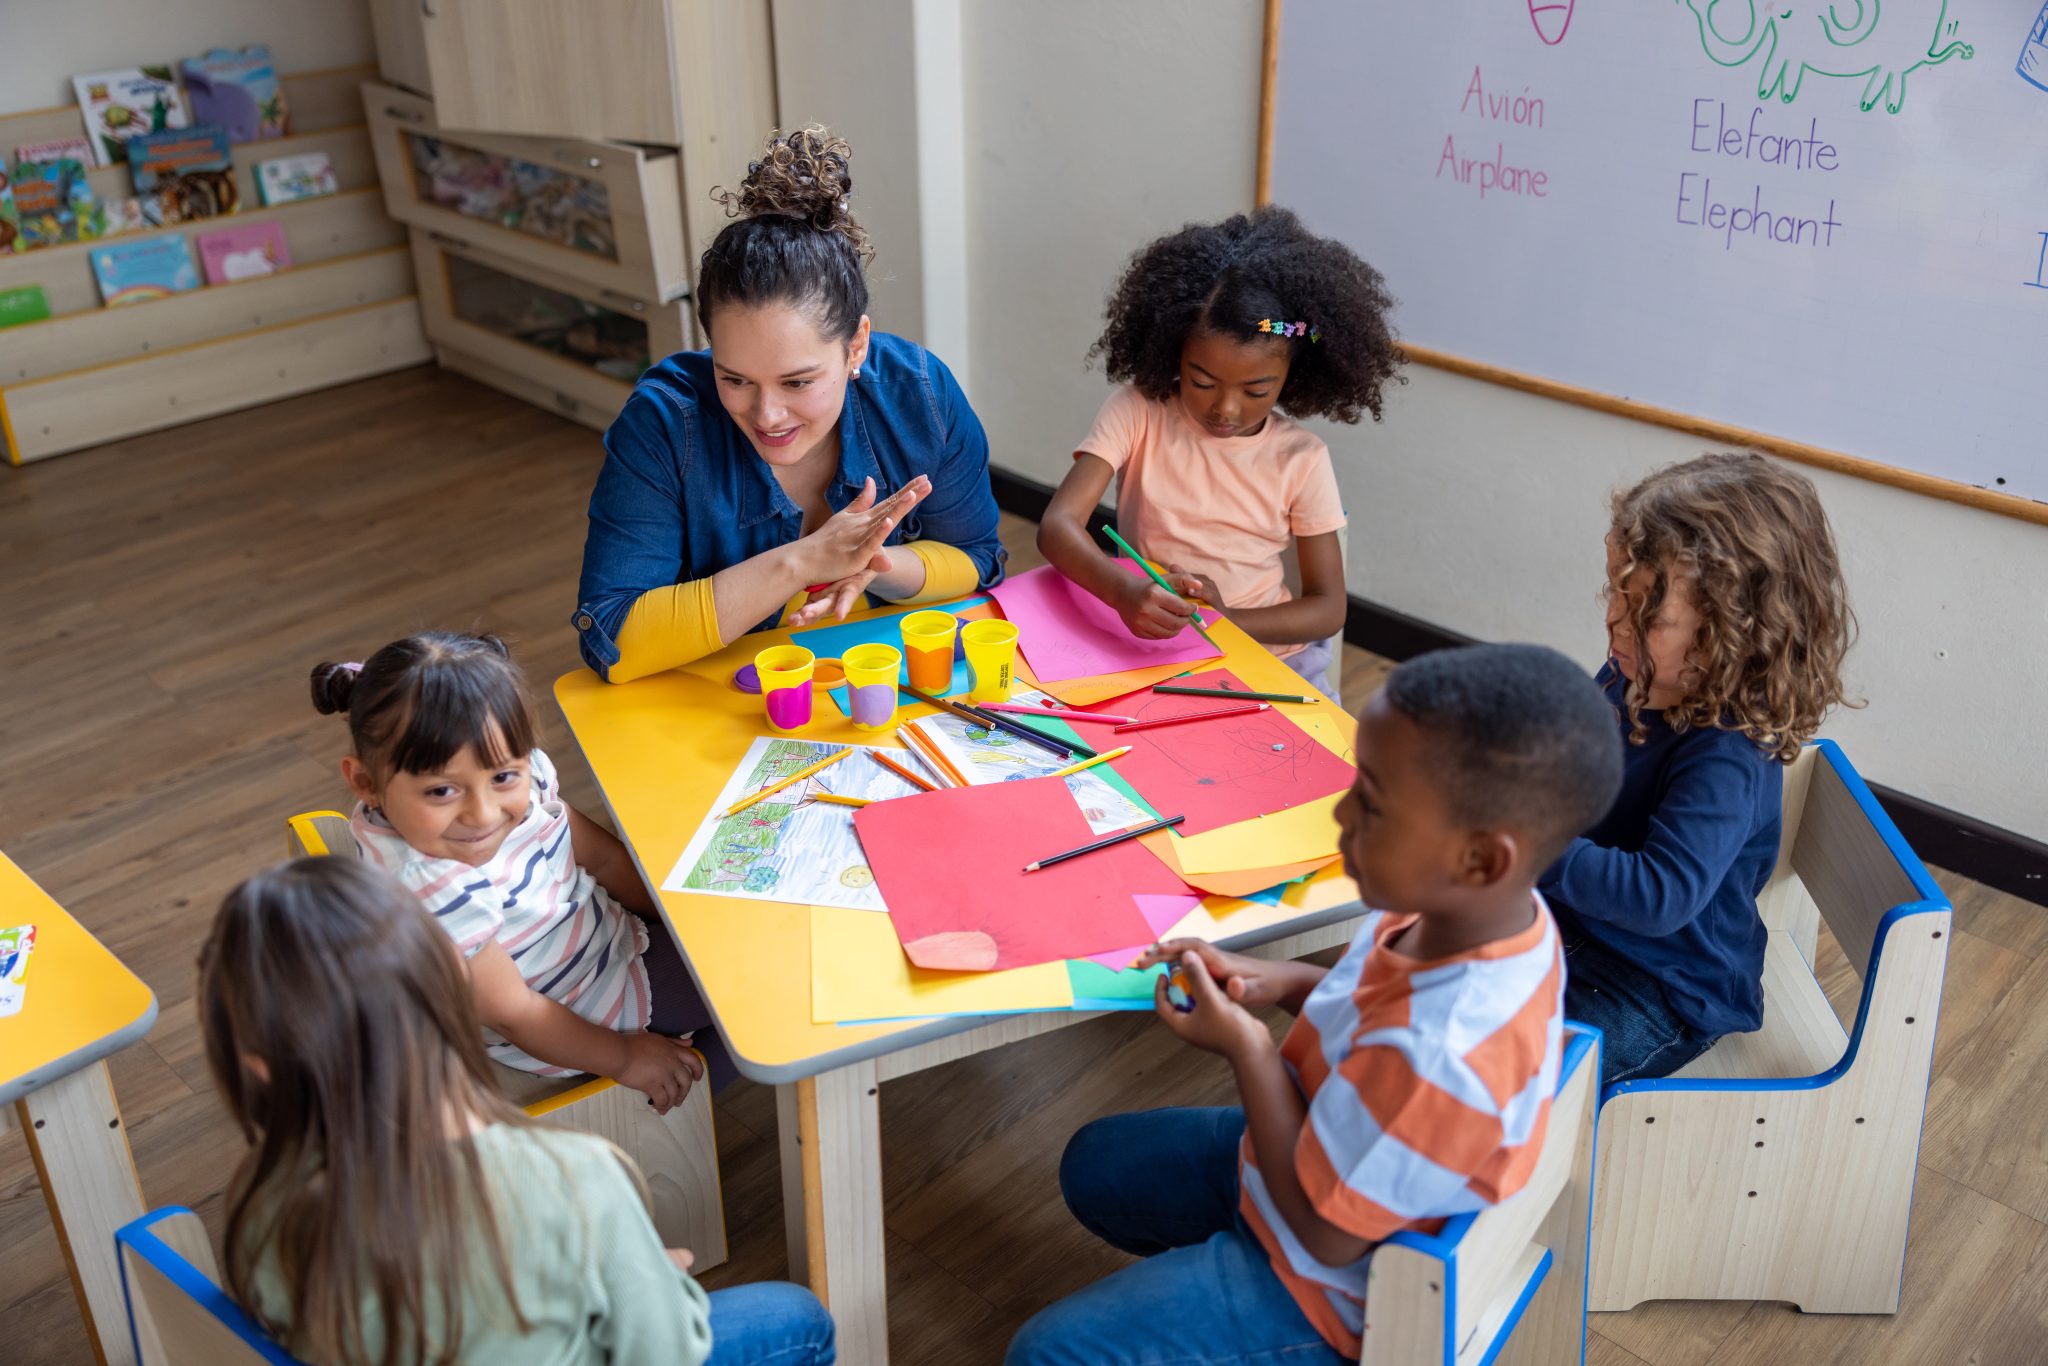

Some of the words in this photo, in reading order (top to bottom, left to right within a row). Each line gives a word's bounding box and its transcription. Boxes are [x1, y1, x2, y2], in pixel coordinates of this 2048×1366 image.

[1460, 64, 1544, 129] Avión
[1436, 134, 1548, 200] Airplane
[1691, 98, 1840, 172] Elefante
[1676, 172, 1843, 251] Elephant
